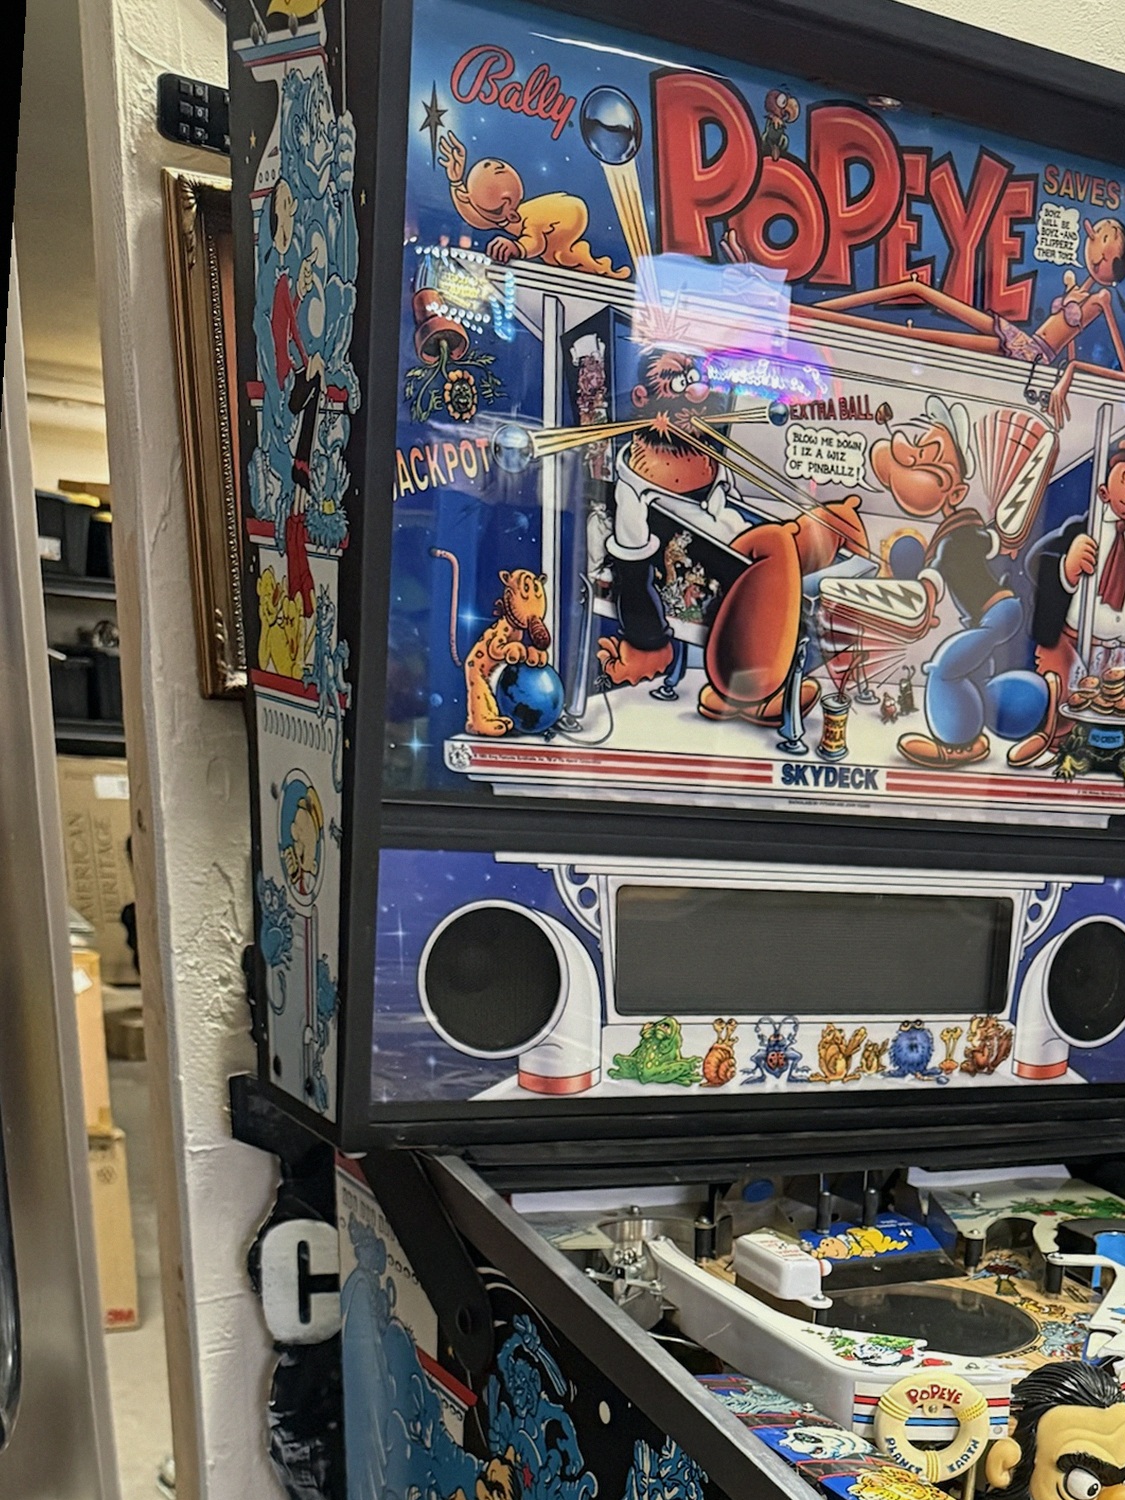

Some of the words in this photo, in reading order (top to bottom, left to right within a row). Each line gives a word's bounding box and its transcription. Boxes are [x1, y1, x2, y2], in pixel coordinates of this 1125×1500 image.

[450, 44, 577, 140] Bally
[650, 66, 1038, 325] POPEYE
[1043, 164, 1120, 211] SAVES
[789, 398, 837, 421] EXTRA
[838, 394, 874, 421] BALL
[793, 432, 818, 445] BLOW
[821, 436, 833, 447] ME
[837, 439, 862, 452] DOWN
[801, 447, 812, 457] IZ
[815, 449, 823, 459] A
[827, 450, 846, 462] WIZ
[392, 437, 490, 501] ACKPOT
[789, 460, 803, 470] OF
[781, 763, 879, 790] SKYDECK
[905, 1384, 963, 1405] POPEYE
[885, 1436, 924, 1475] PLANET
[947, 1438, 980, 1473] EARTH
